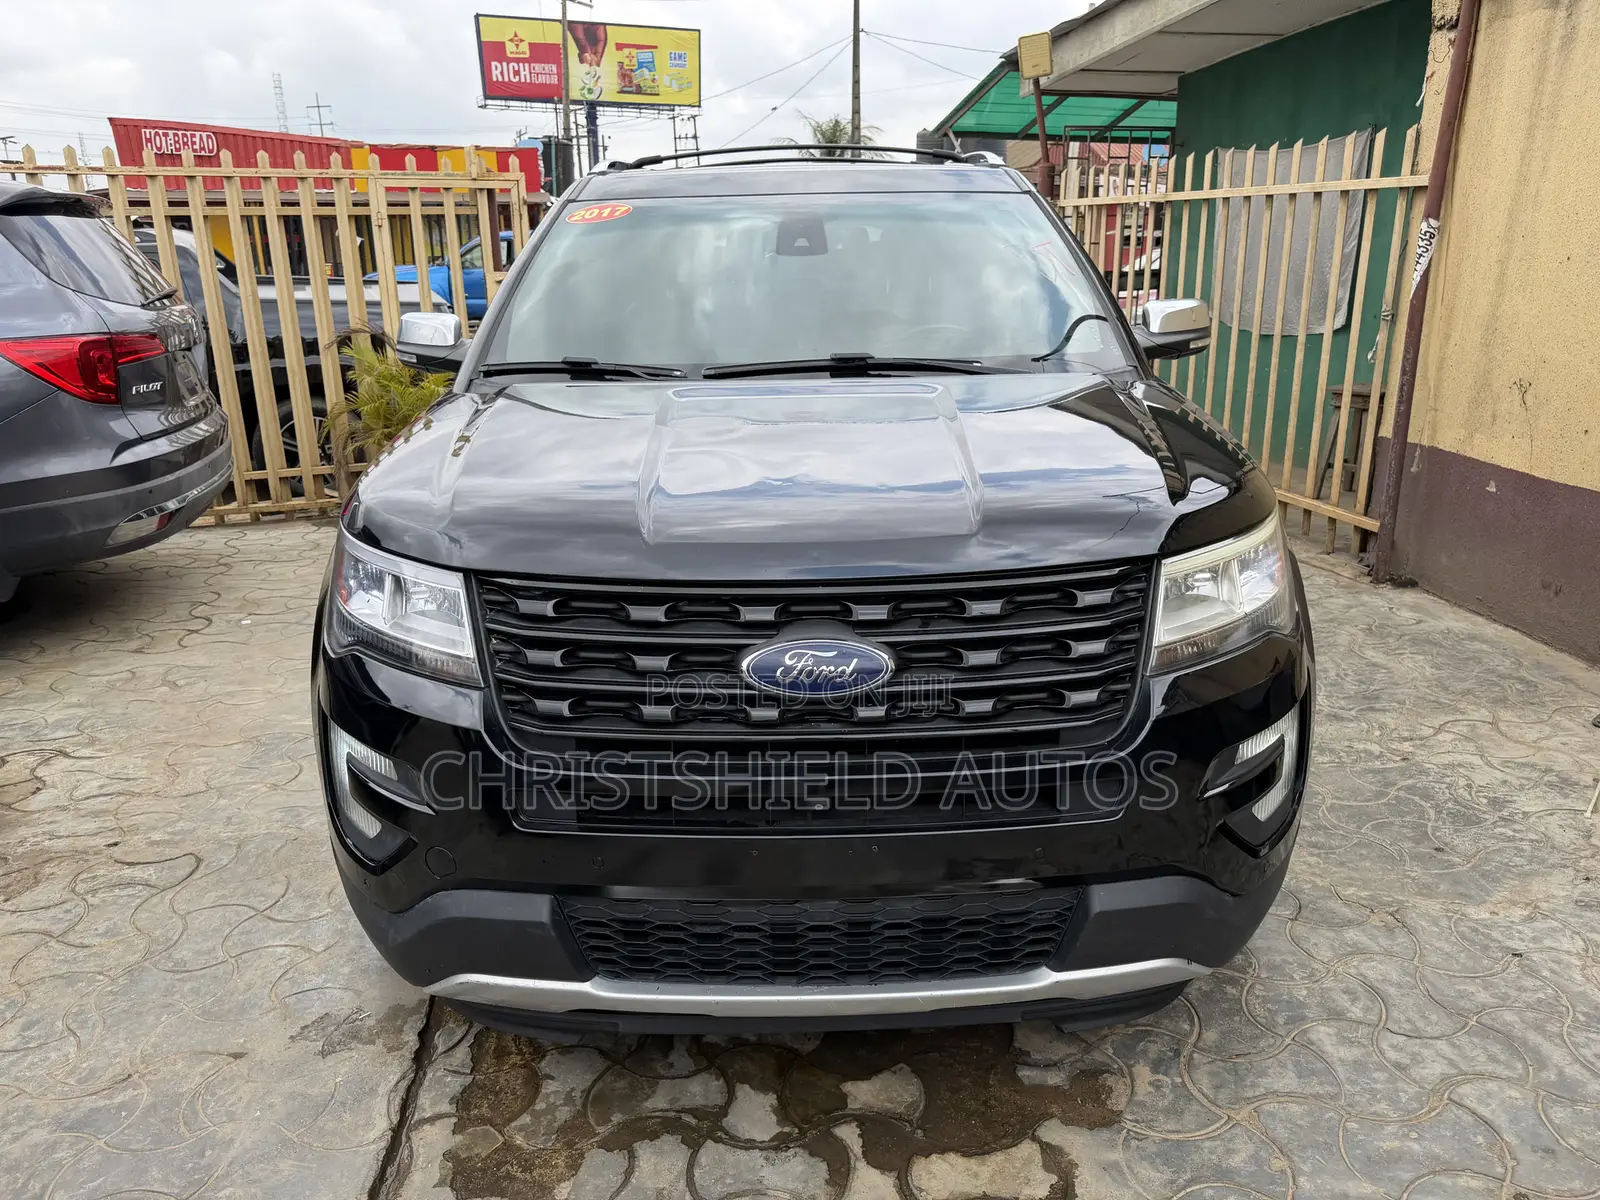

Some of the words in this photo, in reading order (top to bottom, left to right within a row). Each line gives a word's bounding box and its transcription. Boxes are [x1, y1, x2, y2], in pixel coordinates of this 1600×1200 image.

[491, 61, 530, 83] RICH
[531, 63, 557, 74] CHICKEN
[532, 74, 558, 84] FLAVOUR
[570, 207, 630, 220] 2017
[132, 381, 163, 394] PILOT
[776, 649, 858, 683] Ford
